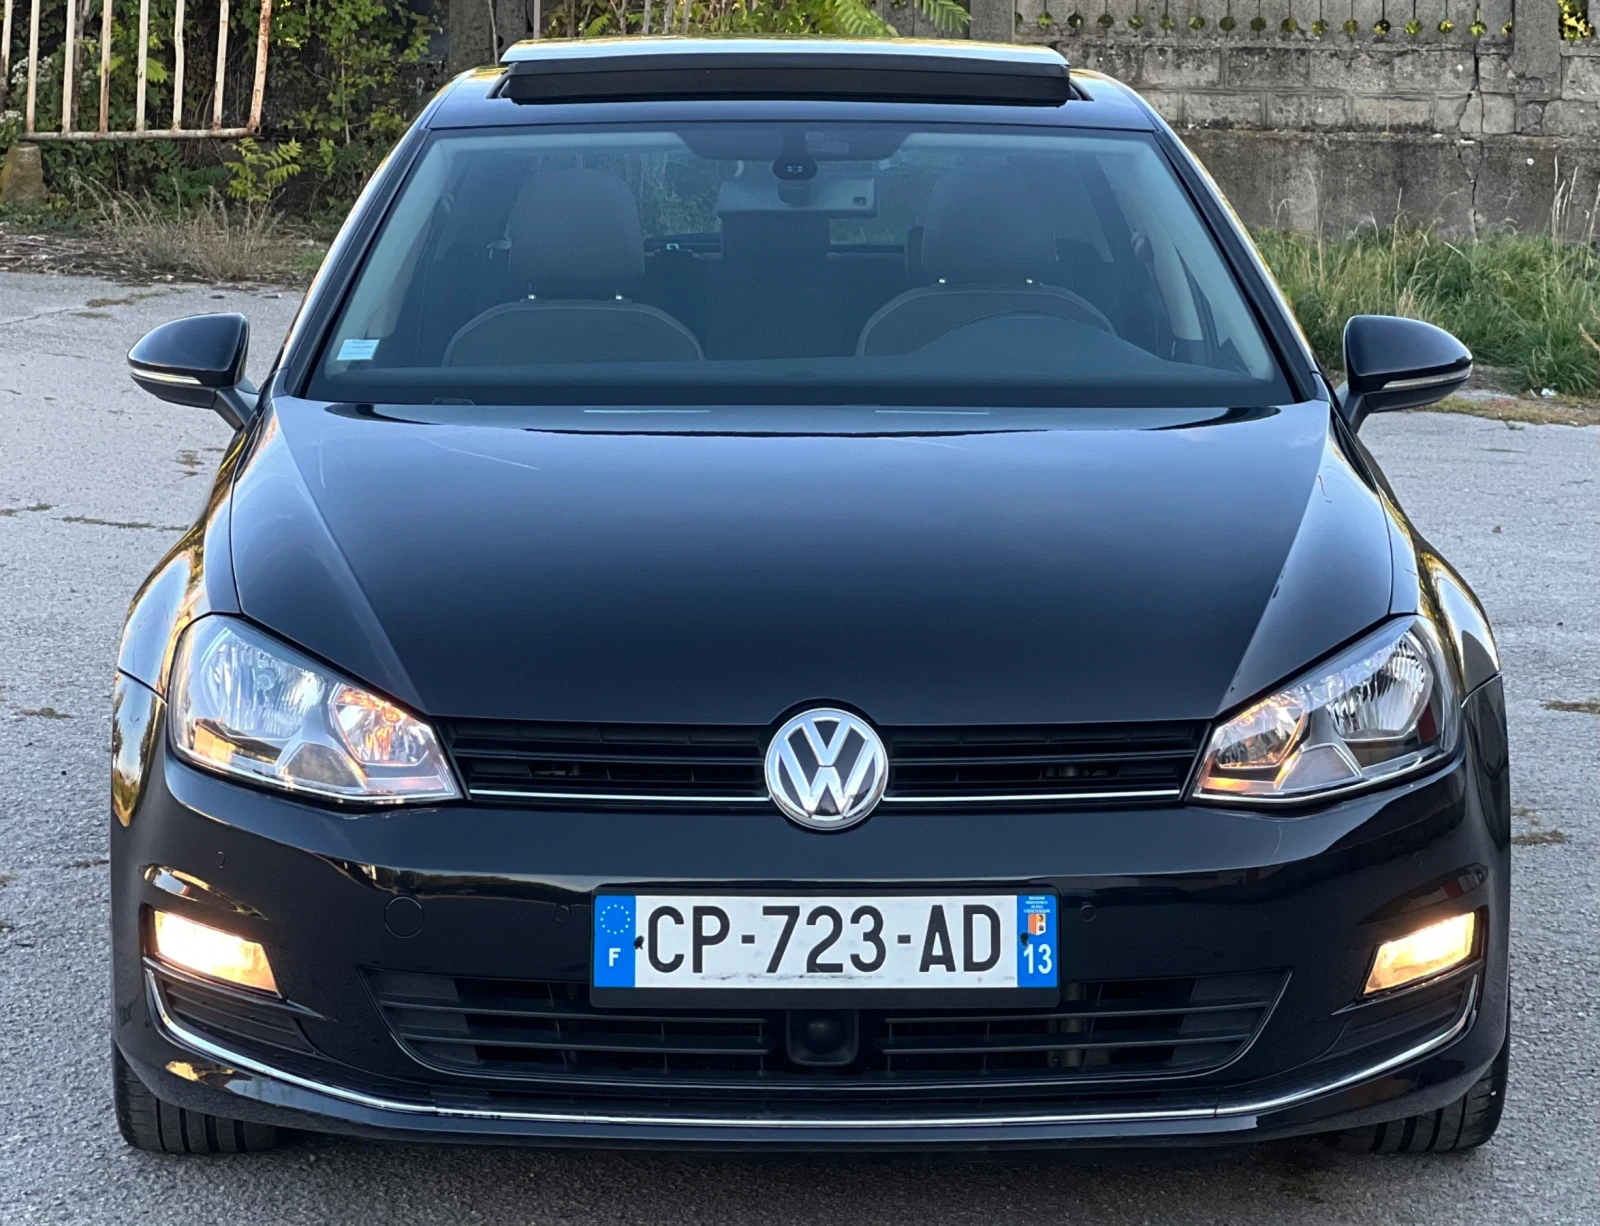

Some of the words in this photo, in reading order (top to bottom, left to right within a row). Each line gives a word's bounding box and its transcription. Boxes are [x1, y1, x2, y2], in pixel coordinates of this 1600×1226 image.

[772, 714, 880, 824] VW
[608, 947, 621, 967] F
[646, 904, 1001, 974] CP-723-AD
[1023, 943, 1053, 974] 13
